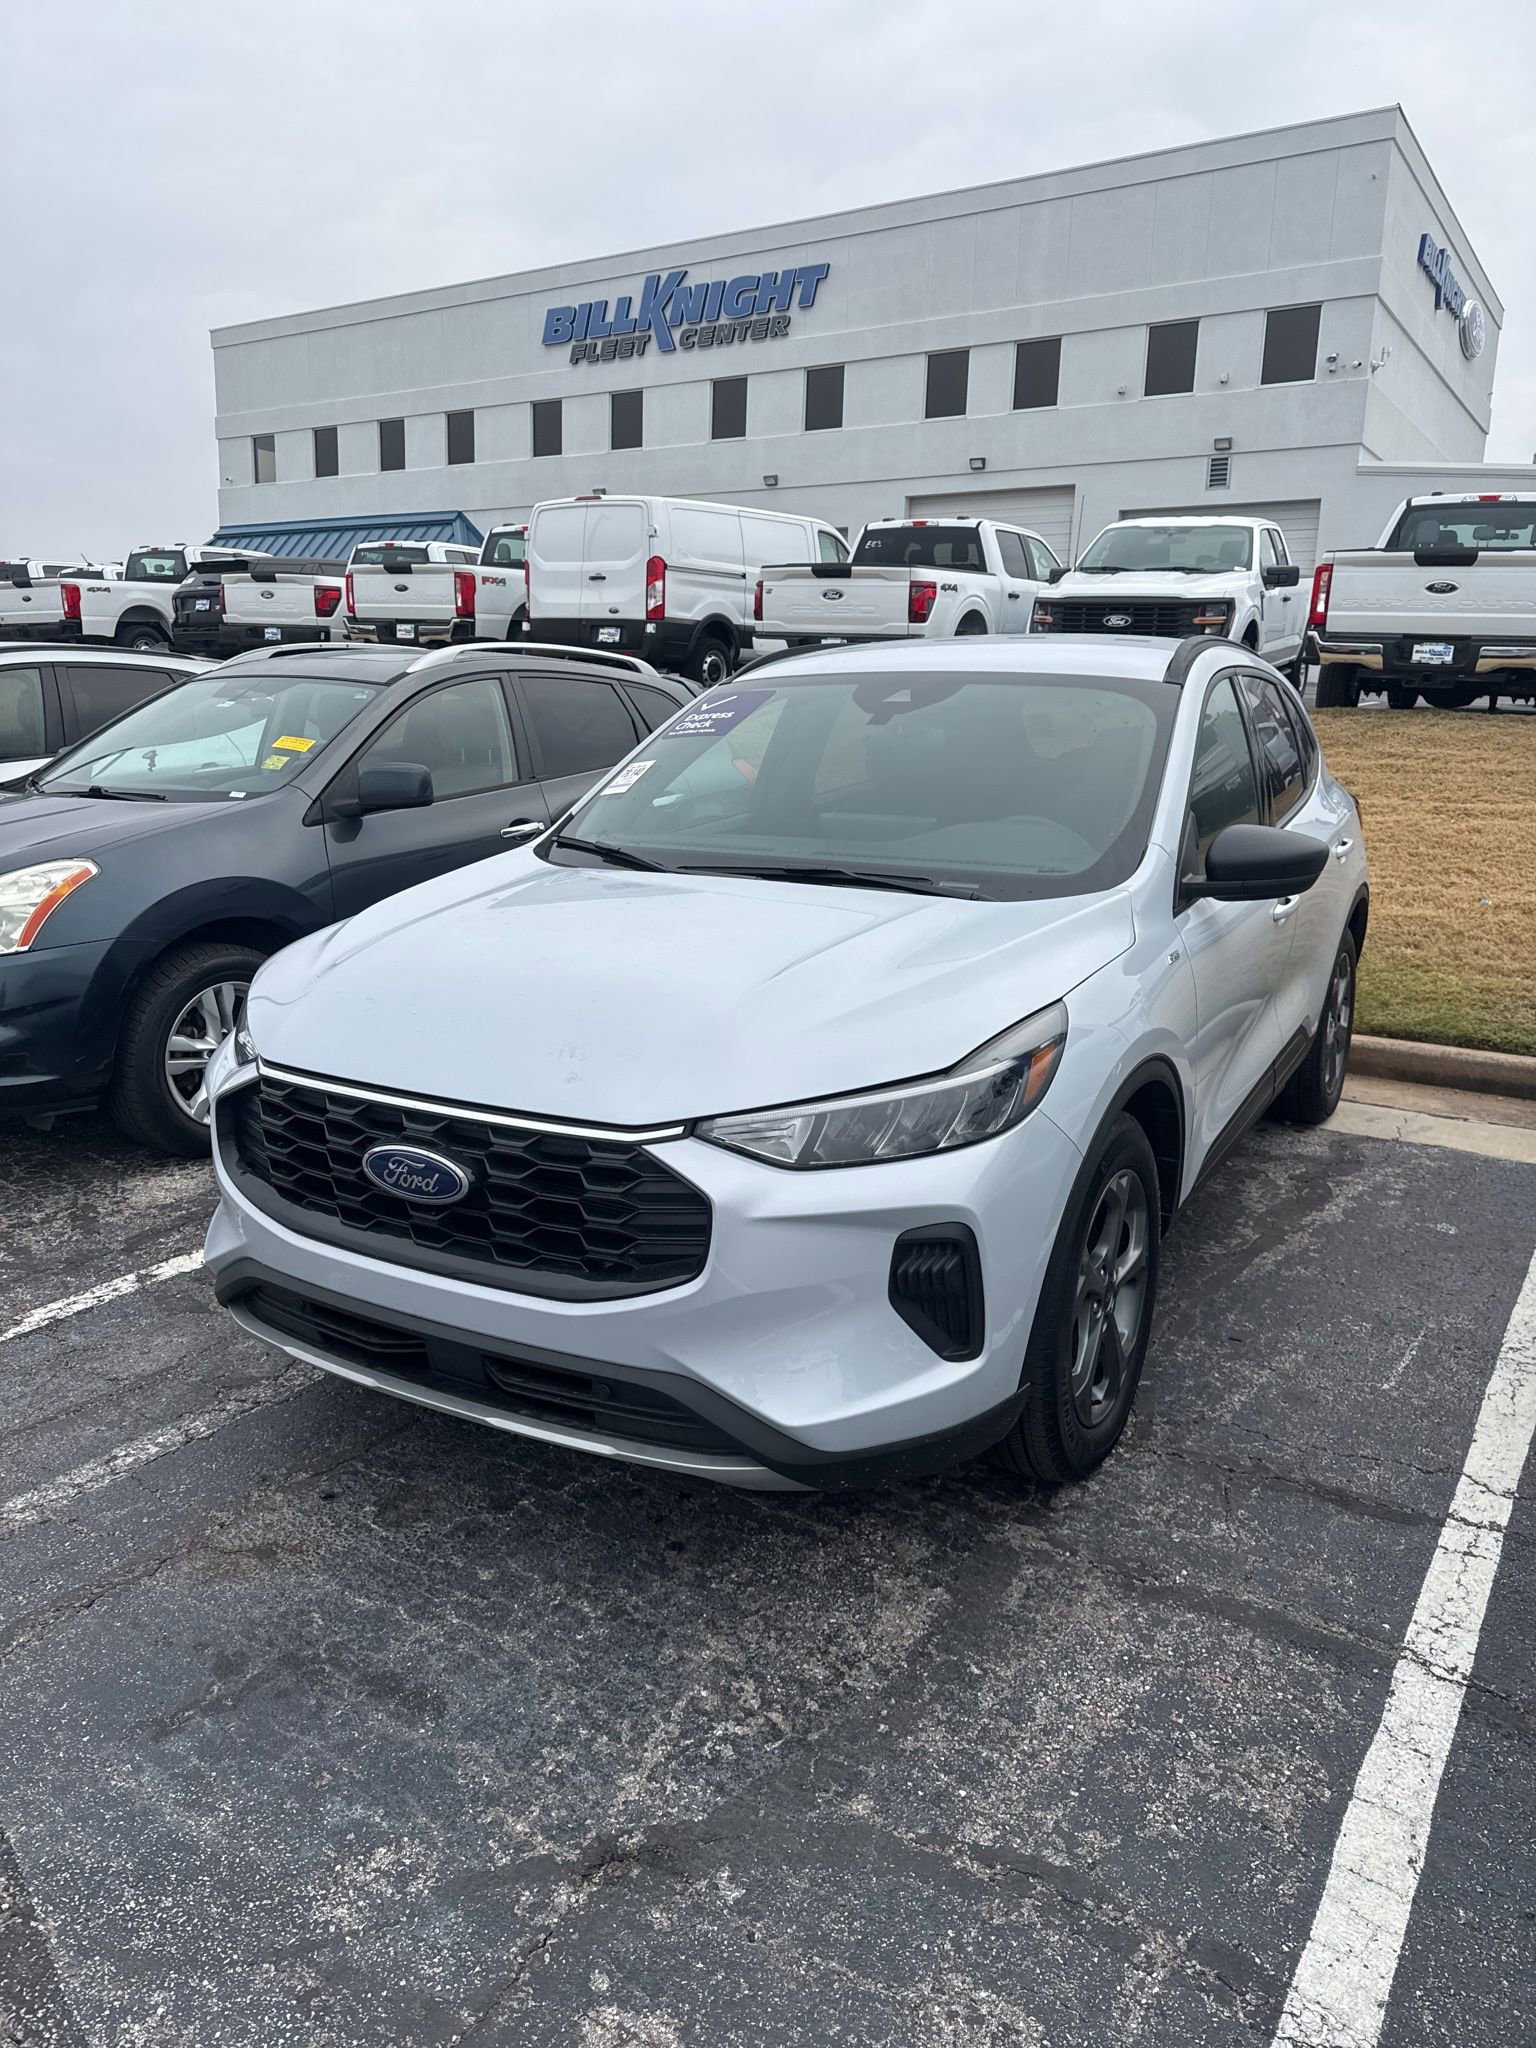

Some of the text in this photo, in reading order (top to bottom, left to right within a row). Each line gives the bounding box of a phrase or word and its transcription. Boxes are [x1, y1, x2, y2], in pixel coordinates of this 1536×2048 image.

[569, 314, 791, 364] FLEET CENTER
[481, 576, 507, 586] FX4
[684, 711, 735, 722] Express
[675, 720, 714, 730] Check
[383, 1156, 440, 1193] Ford
